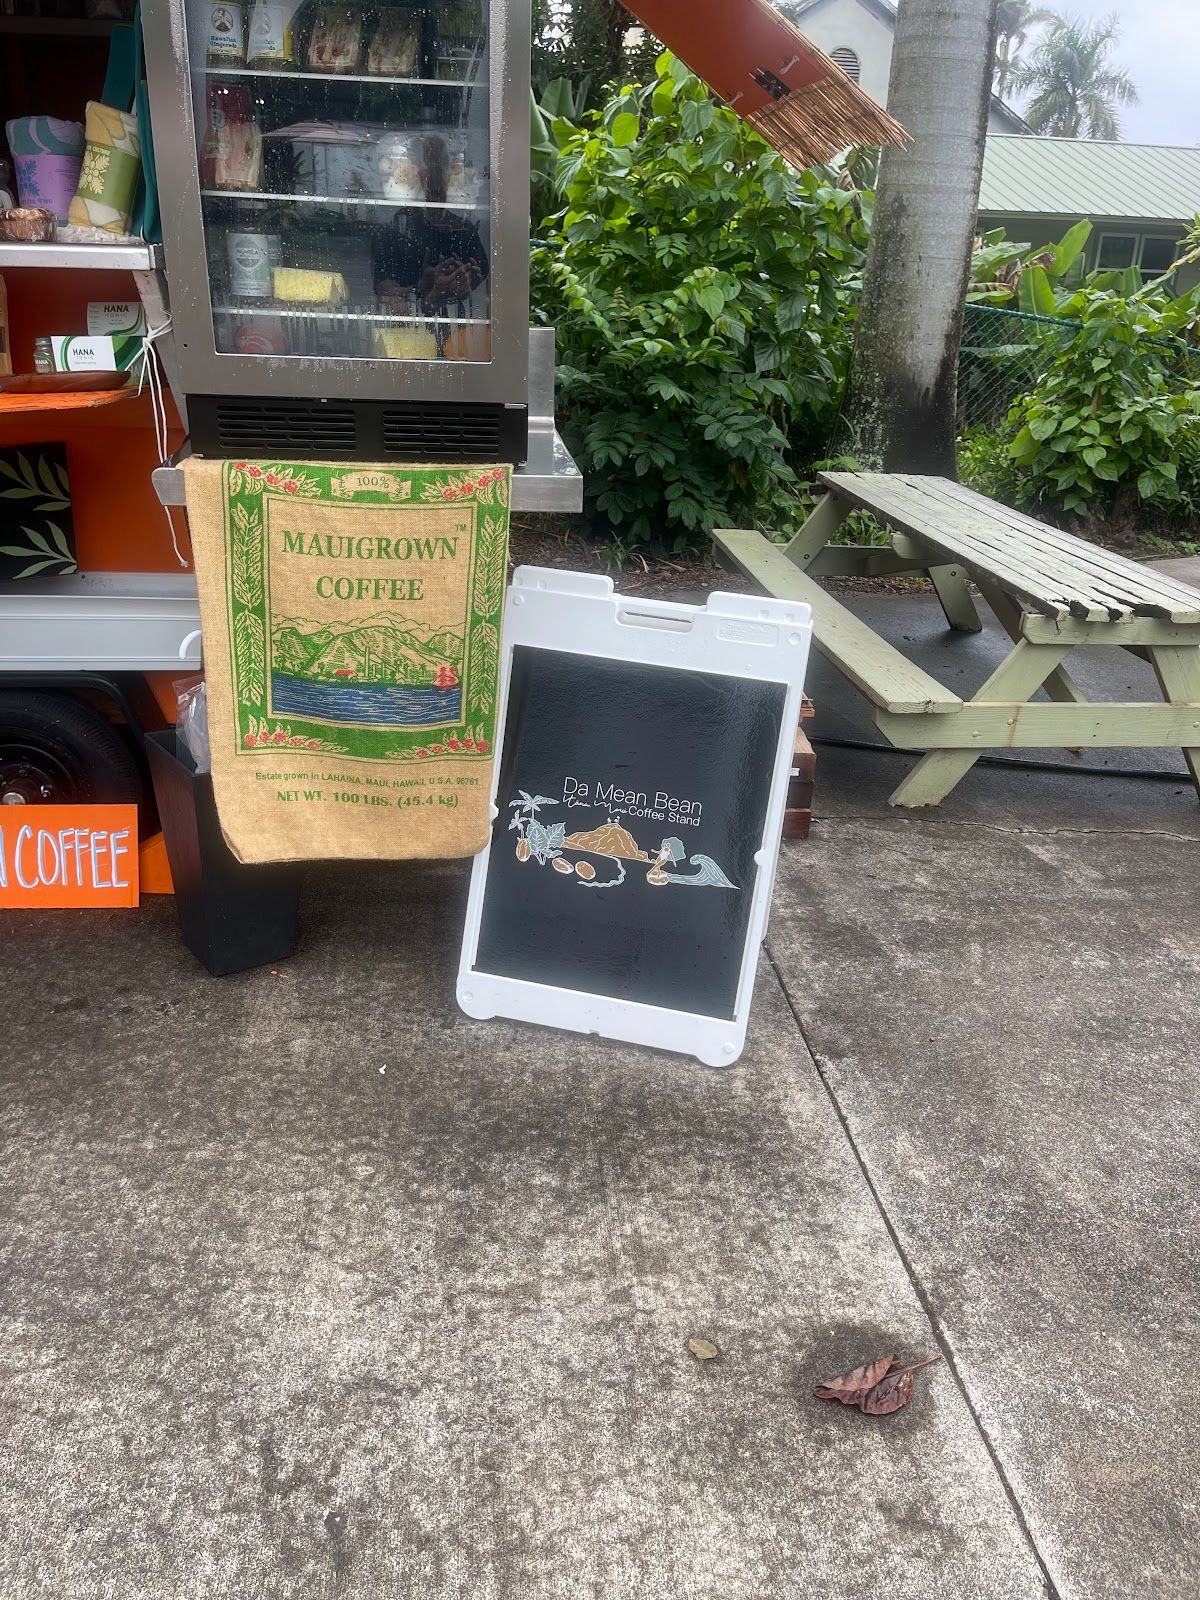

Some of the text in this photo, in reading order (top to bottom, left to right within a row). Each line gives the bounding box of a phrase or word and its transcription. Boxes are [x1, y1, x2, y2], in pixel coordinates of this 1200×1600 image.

[103, 304, 130, 313] HANA
[72, 348, 95, 356] HANA
[357, 476, 391, 489] 100%
[281, 530, 459, 560] MAUIGROWN
[315, 575, 424, 601] COFFEE
[255, 772, 282, 781] Estate
[283, 772, 309, 782] grown
[311, 771, 320, 780] in
[456, 777, 479, 786] 96761
[276, 790, 459, 810] NET WT. 100 LBS. (45.4 kg)
[563, 776, 703, 816] Da Mean Bean
[628, 805, 702, 827] Coffee Stand
[14, 825, 129, 889] COFFEE
